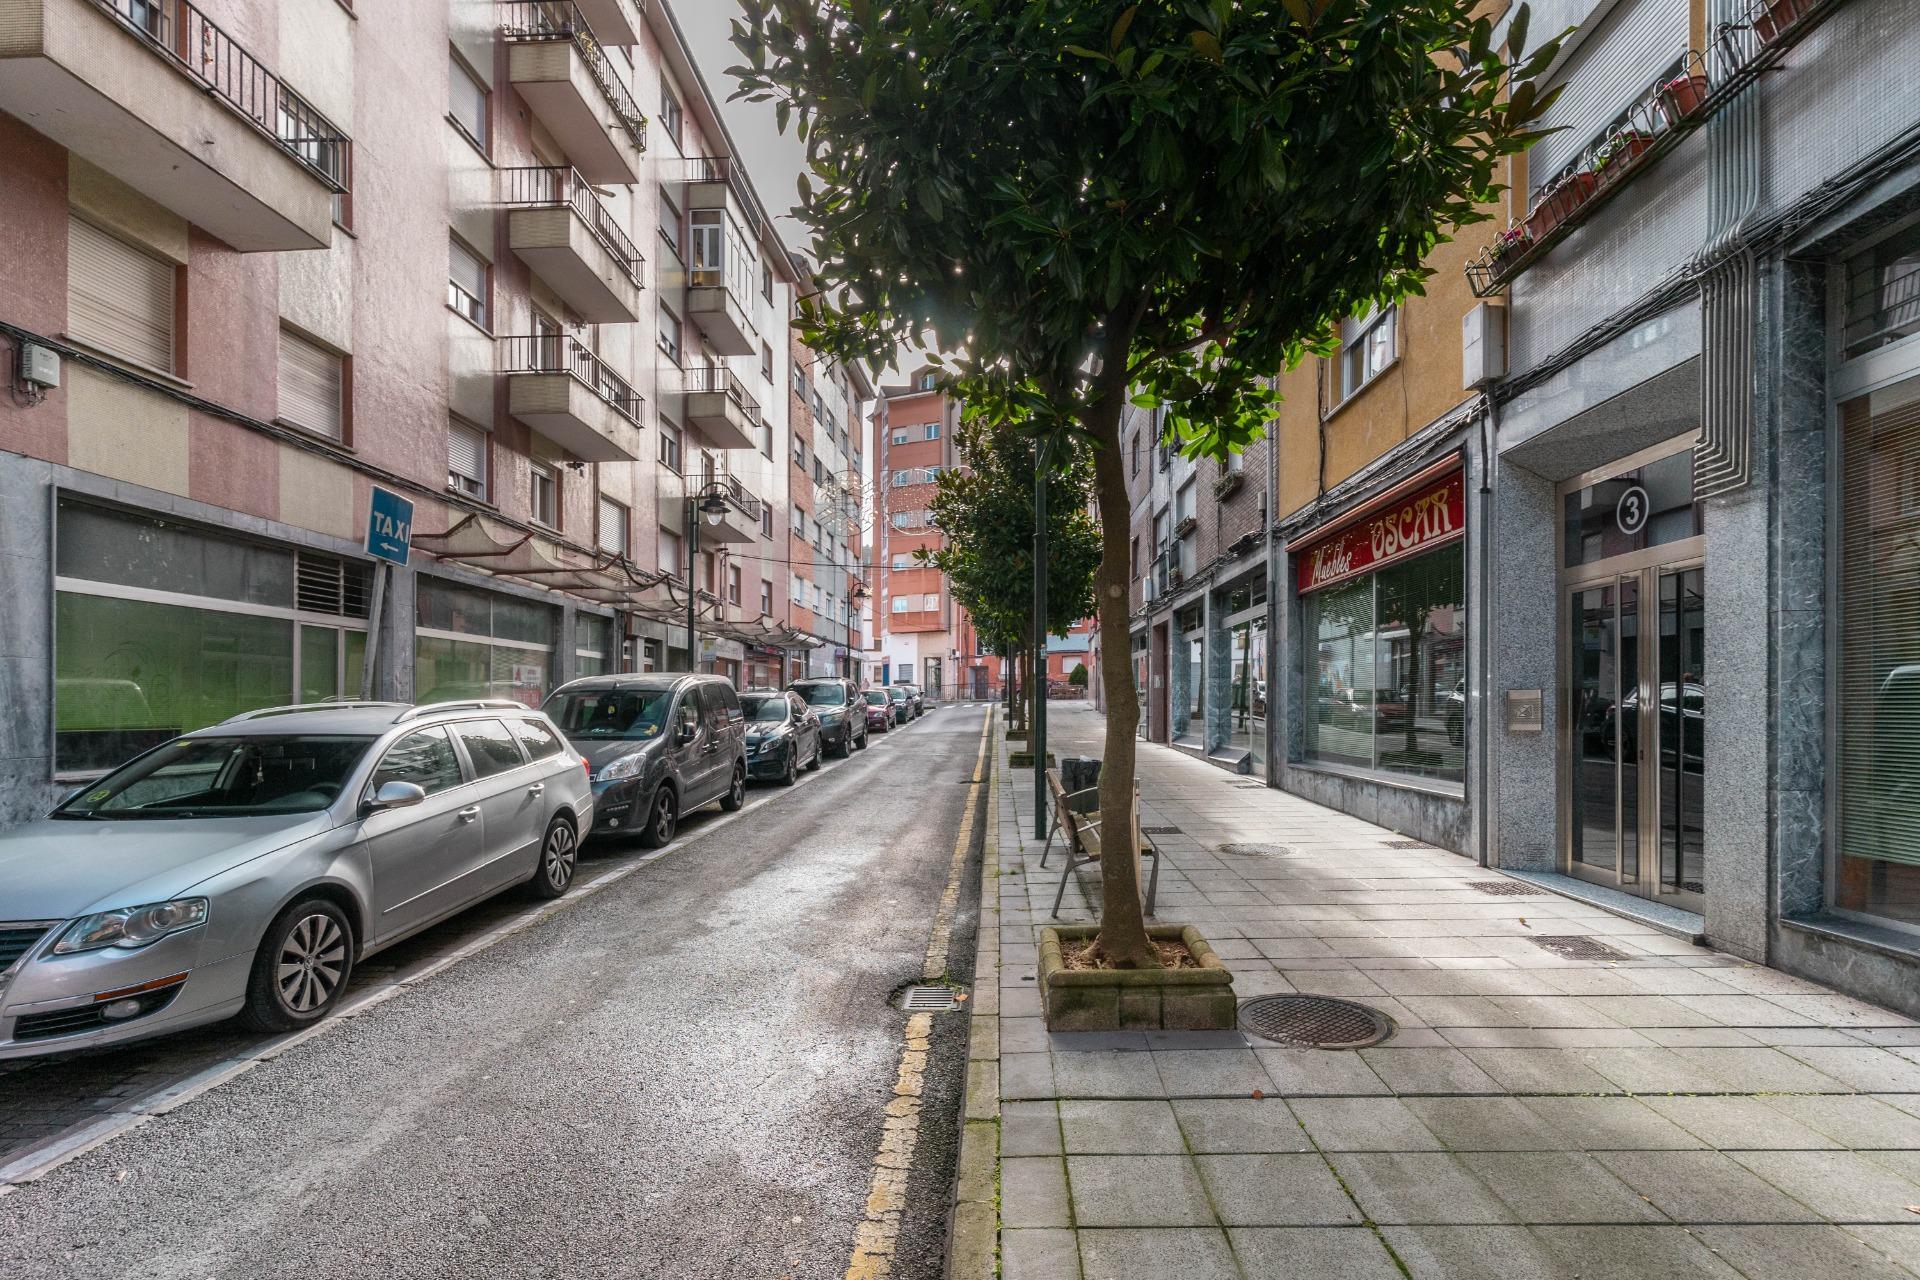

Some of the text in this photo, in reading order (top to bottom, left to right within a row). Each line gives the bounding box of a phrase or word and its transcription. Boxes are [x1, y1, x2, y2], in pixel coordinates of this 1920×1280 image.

[1626, 496, 1640, 525] 3
[374, 511, 409, 543] TAXI
[1311, 488, 1453, 586] Muebles OSCAR
